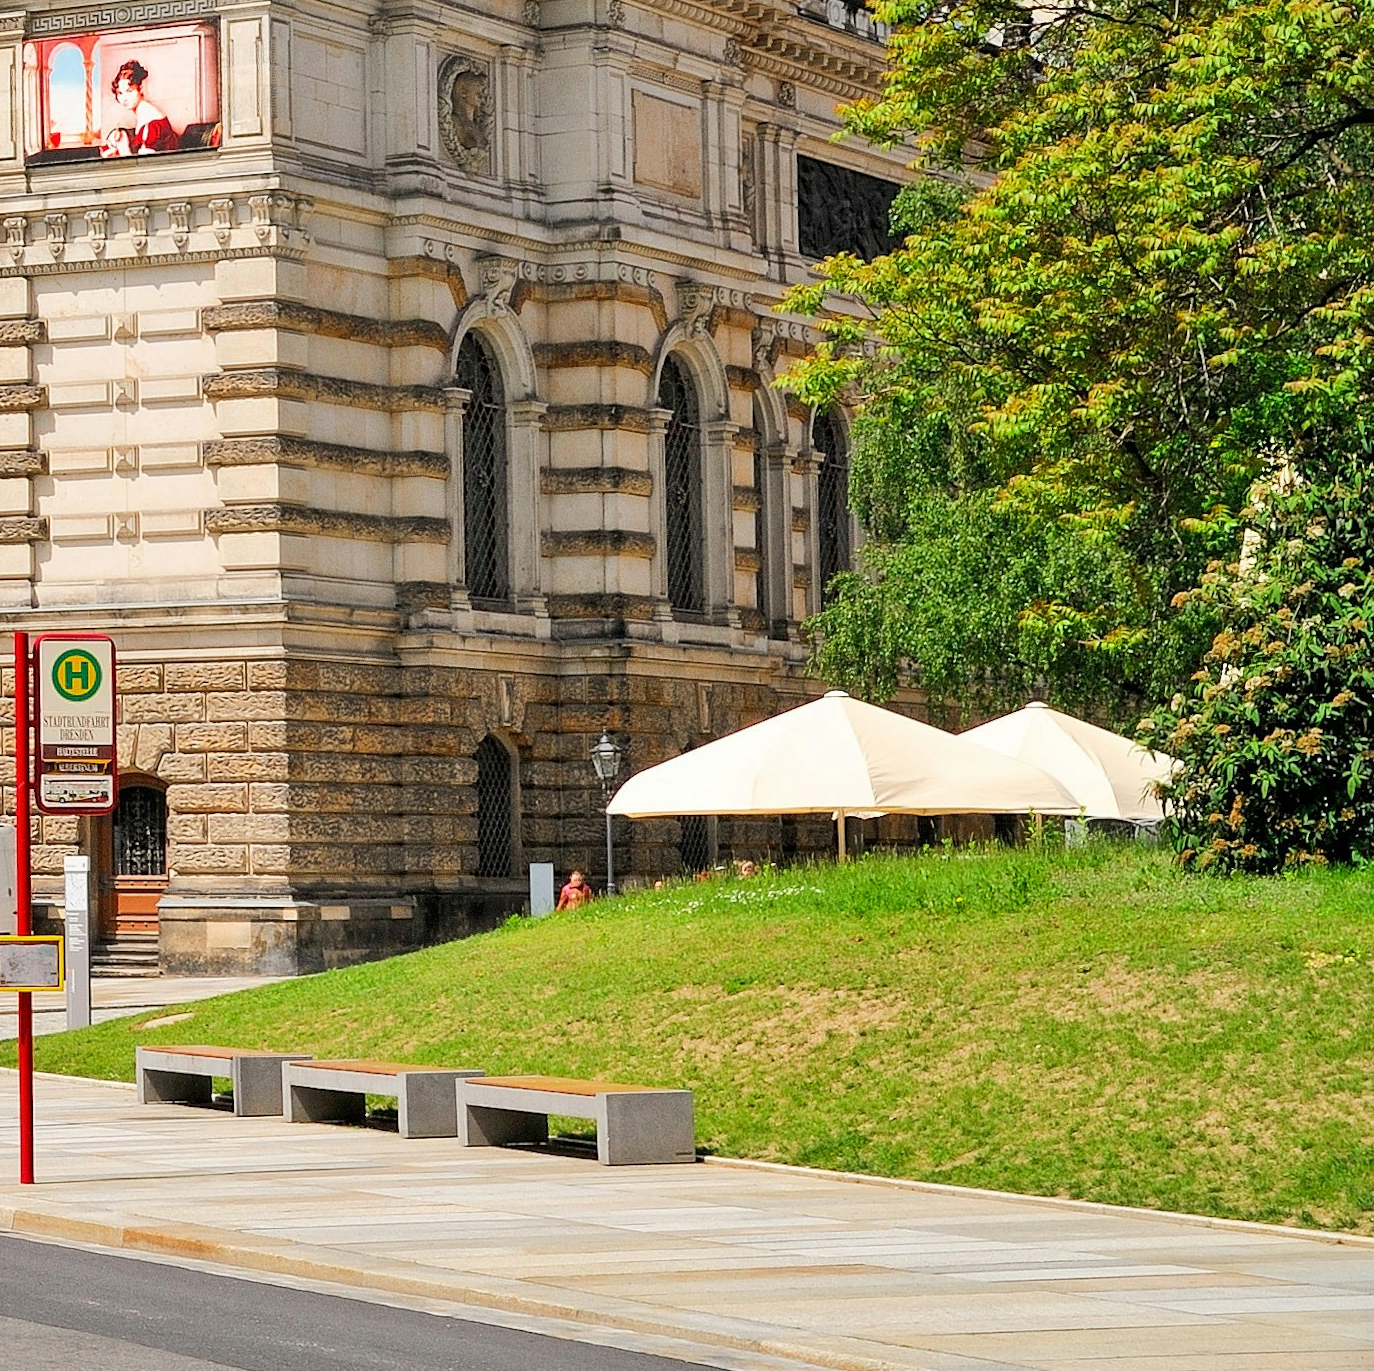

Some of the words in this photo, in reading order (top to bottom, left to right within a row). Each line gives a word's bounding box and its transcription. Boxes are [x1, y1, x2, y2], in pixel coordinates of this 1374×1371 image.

[64, 661, 89, 690] H
[43, 715, 110, 728] STADTRUNDFAHRT
[60, 729, 94, 741] DRESDEN
